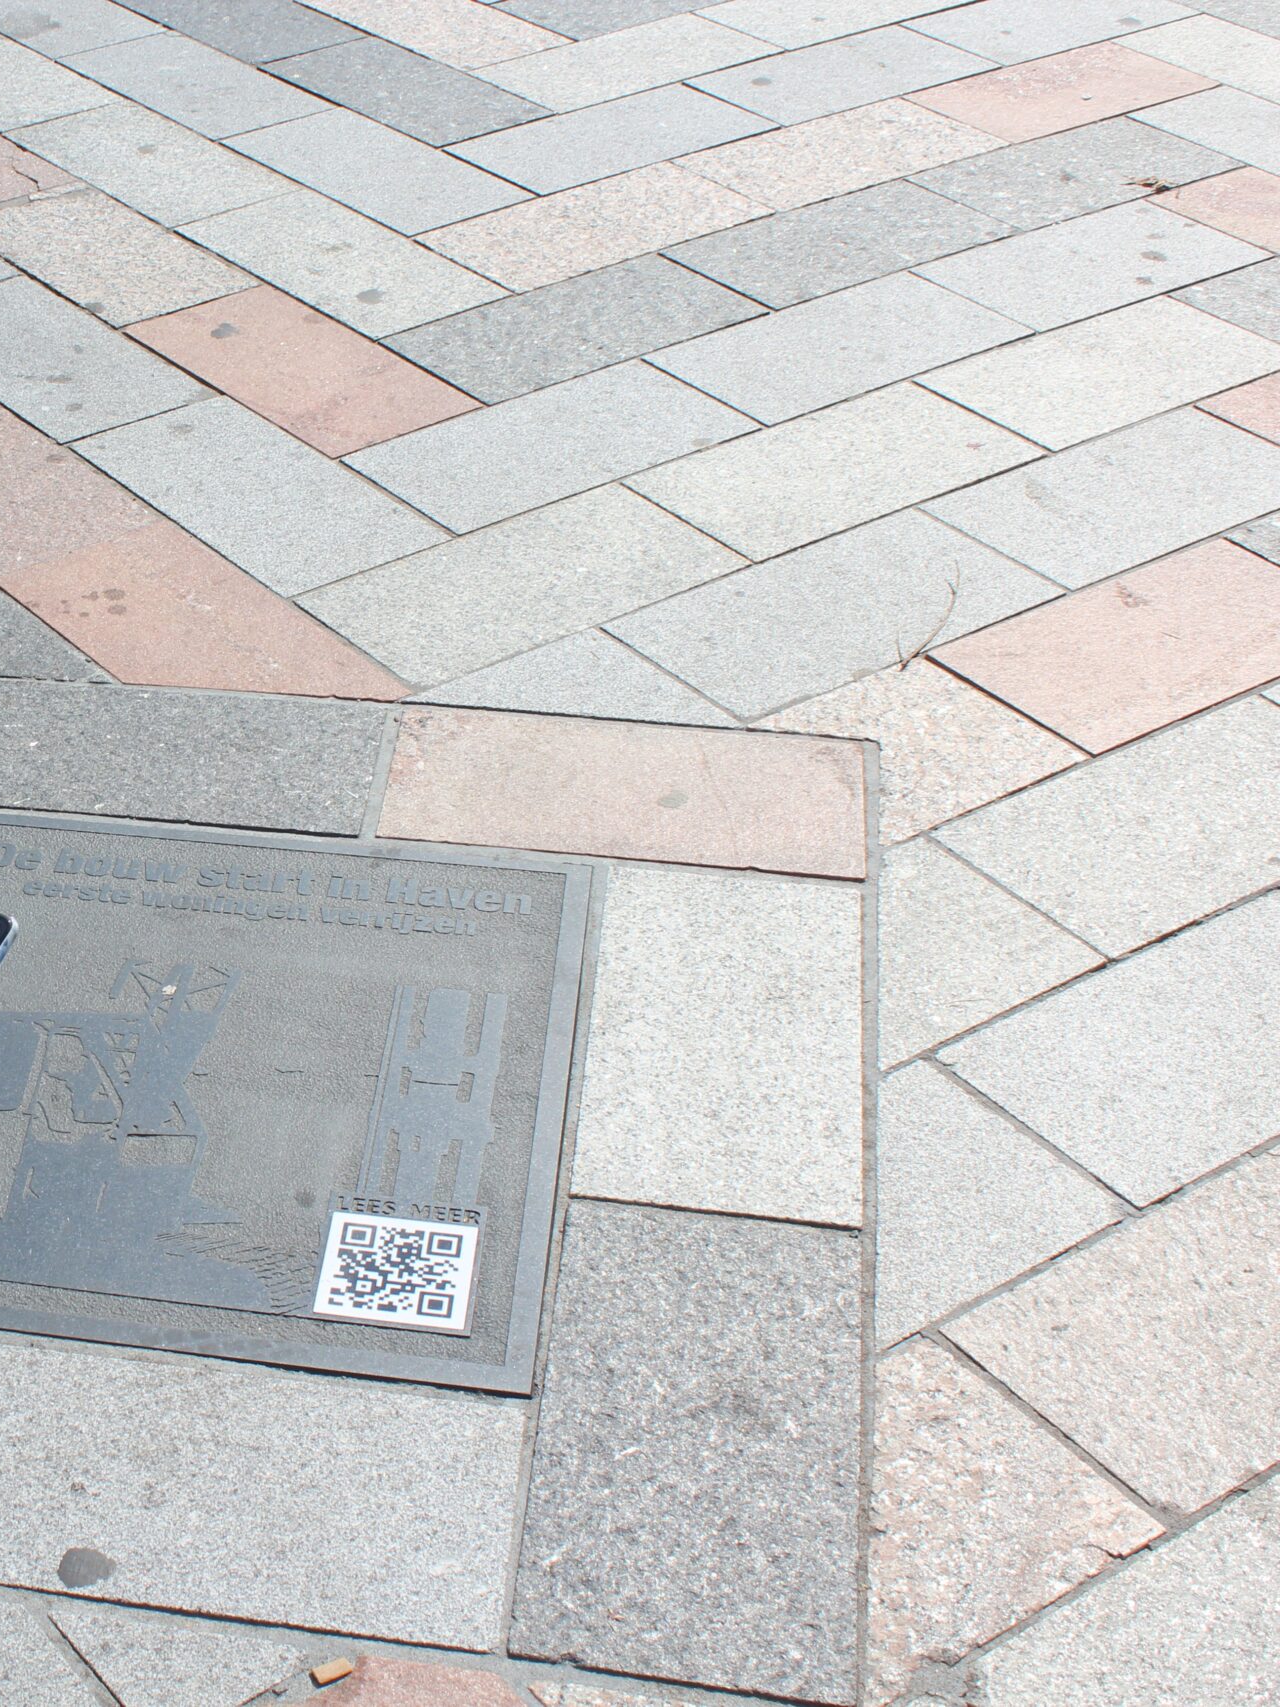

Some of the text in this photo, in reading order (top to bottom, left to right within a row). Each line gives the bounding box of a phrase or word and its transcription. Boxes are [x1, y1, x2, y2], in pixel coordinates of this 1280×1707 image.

[23, 878, 478, 936] eerste woningen verrijzen
[54, 847, 189, 884] bouw
[196, 863, 316, 897] start
[326, 873, 371, 902] in
[386, 877, 533, 916] Haven
[336, 1195, 482, 1225] LEES MEER
